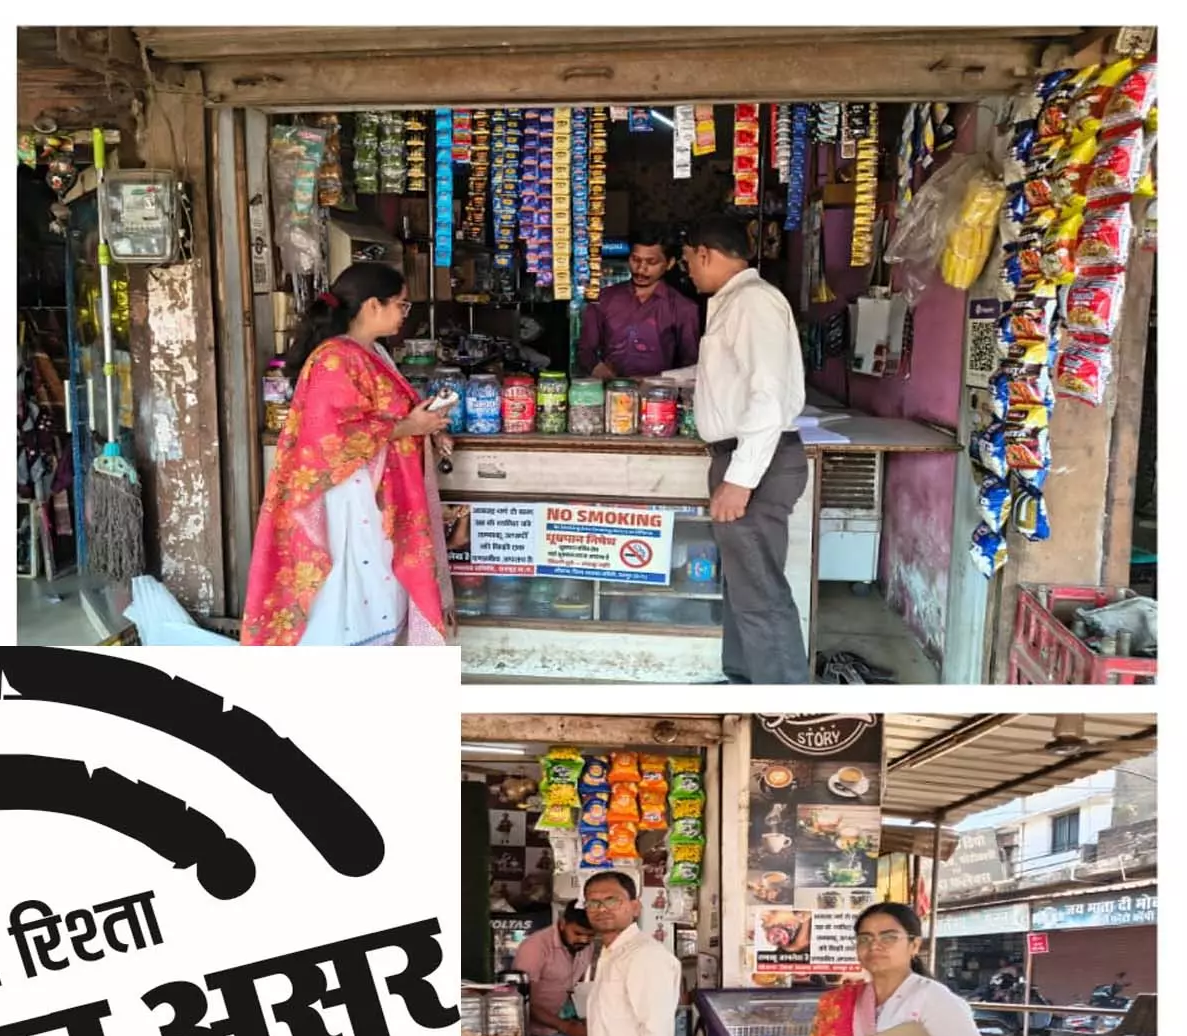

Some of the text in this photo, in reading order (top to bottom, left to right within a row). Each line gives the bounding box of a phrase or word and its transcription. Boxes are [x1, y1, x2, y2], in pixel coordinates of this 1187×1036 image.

[546, 508, 662, 527] NO SMOKING
[797, 730, 841, 747] STORY
